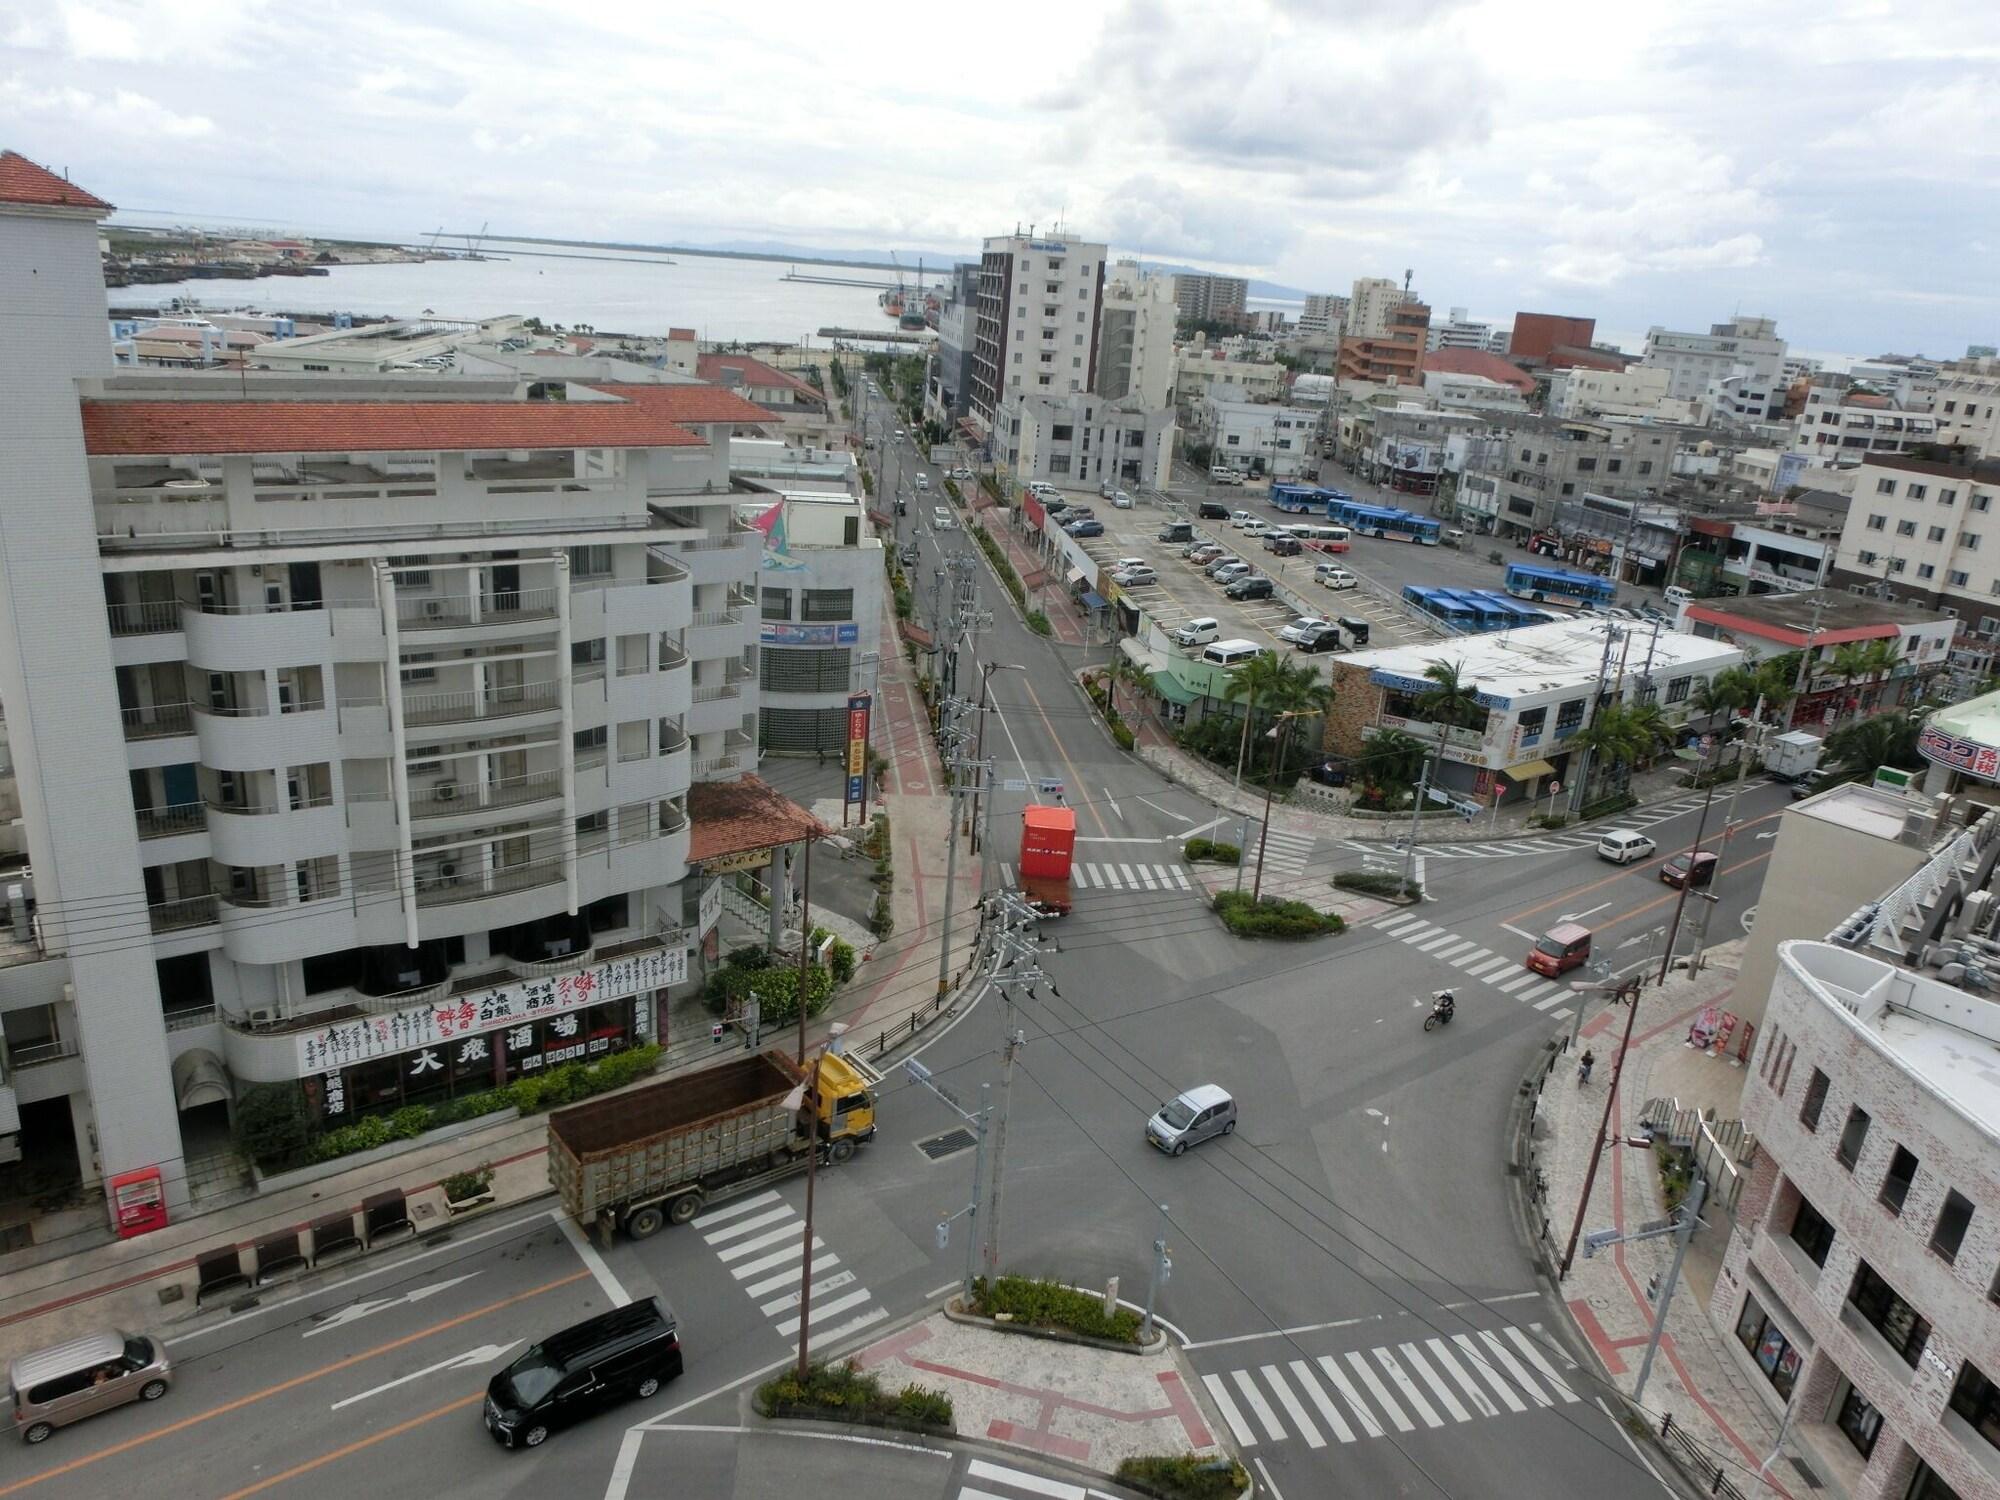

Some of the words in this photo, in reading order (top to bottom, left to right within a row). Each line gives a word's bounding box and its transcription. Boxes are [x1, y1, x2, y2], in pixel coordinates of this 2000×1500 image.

[1975, 749, 1998, 775] 免税
[410, 1012, 579, 1075] 大衆酒場
